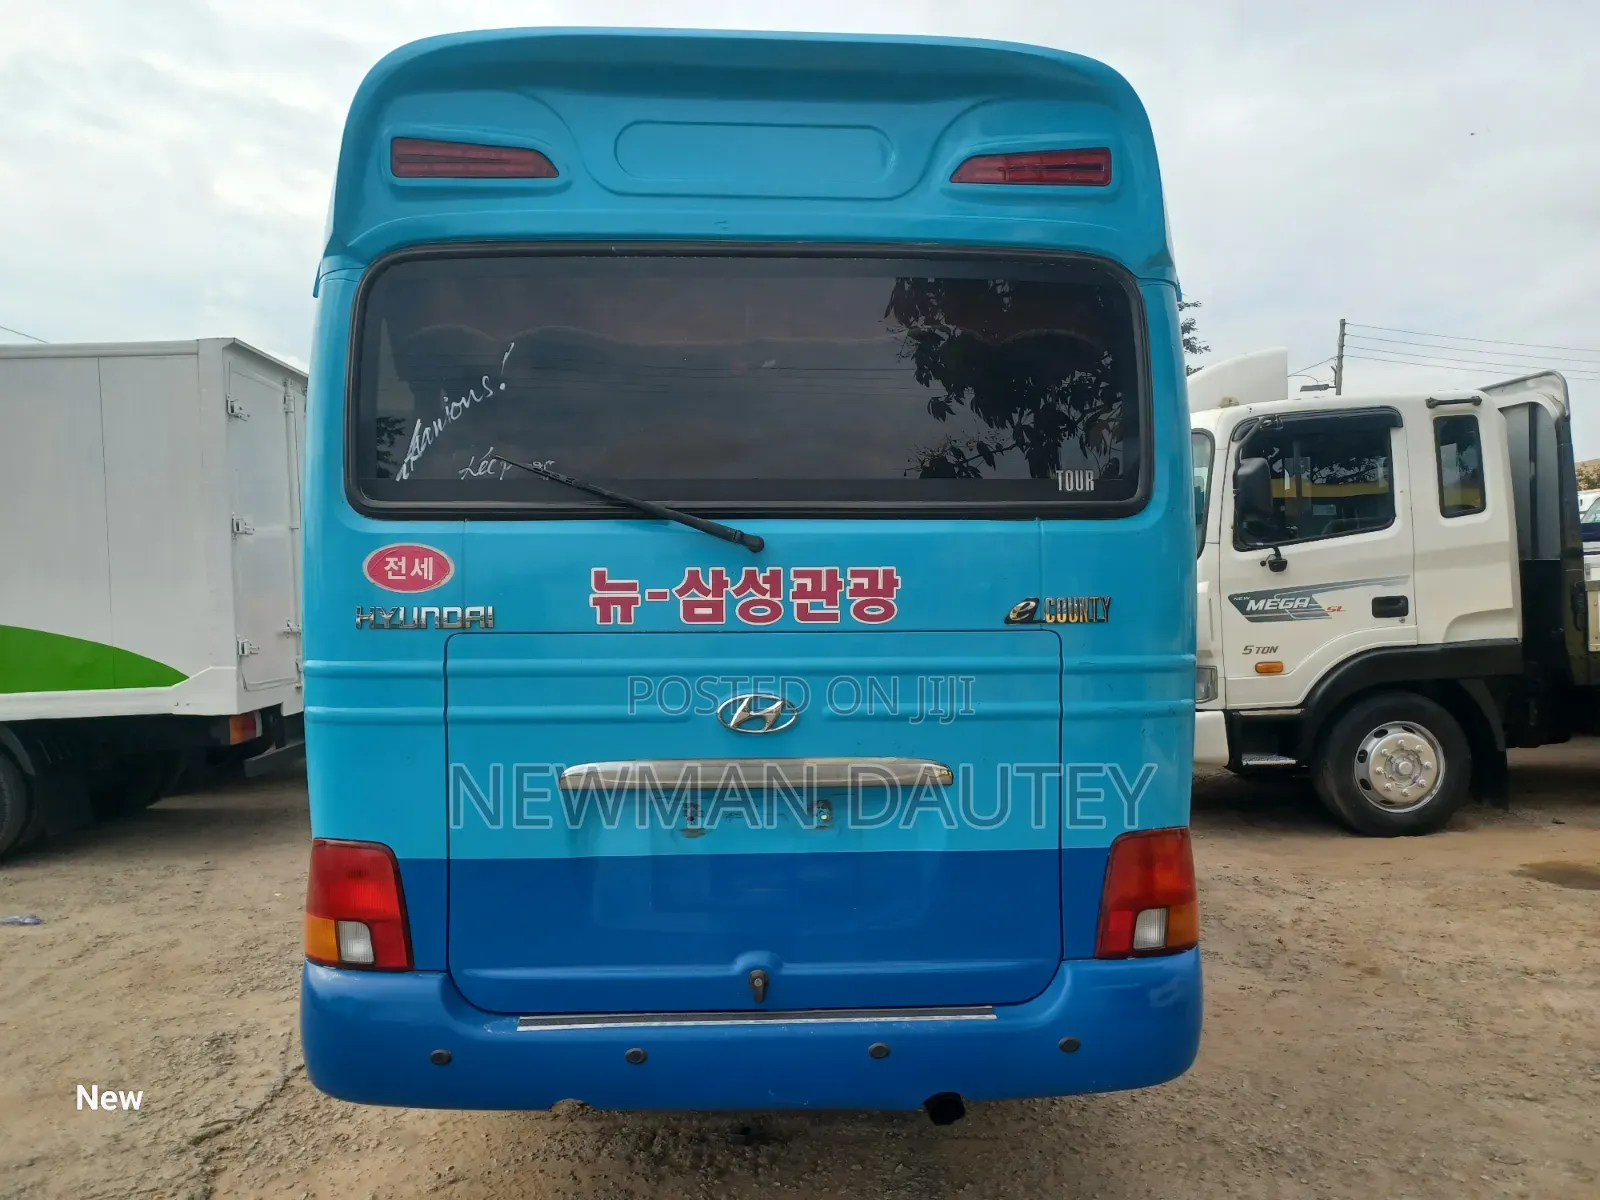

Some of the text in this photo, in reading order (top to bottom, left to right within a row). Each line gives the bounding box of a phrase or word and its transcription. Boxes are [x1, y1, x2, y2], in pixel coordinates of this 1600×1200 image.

[1055, 469, 1095, 492] TOUR
[383, 556, 434, 581] 전세
[589, 567, 901, 625] 뉴-삼성관광
[1245, 597, 1347, 613] MEGA SL
[355, 605, 495, 630] HYUNDAI
[1044, 596, 1112, 623] COUNTY
[1241, 645, 1279, 655] 5 TON
